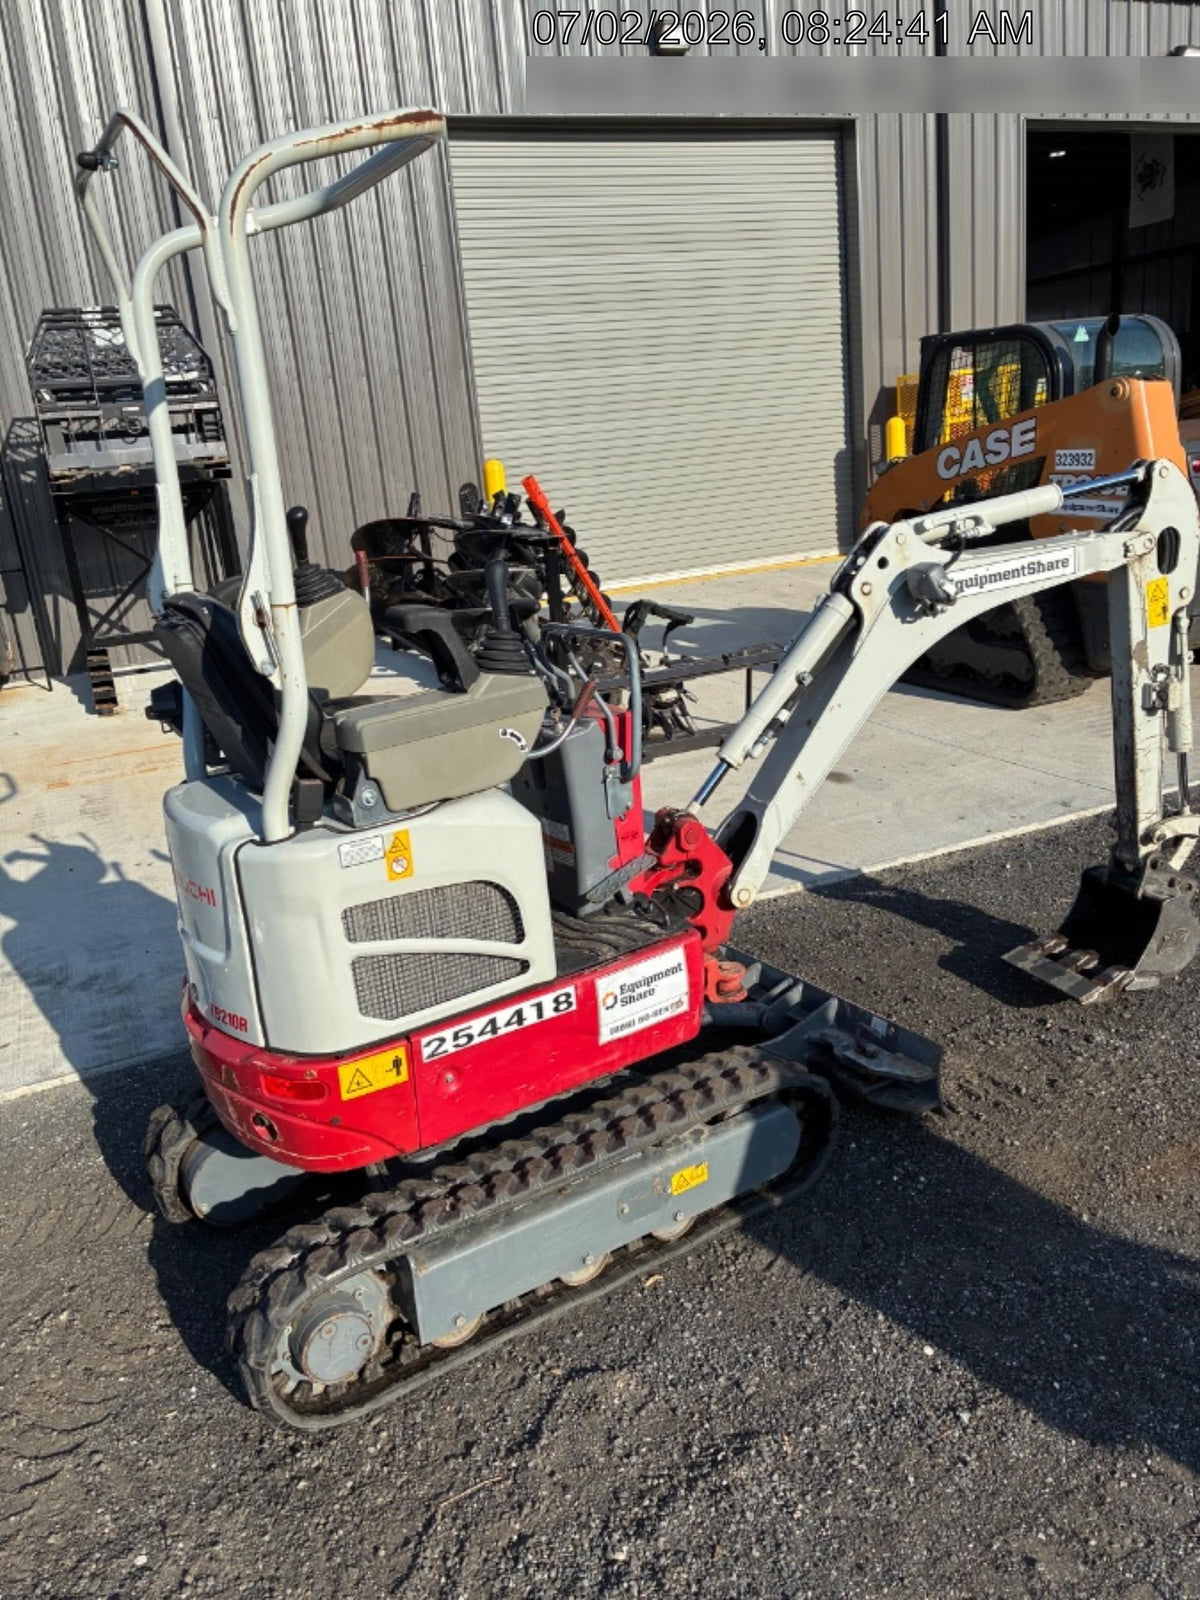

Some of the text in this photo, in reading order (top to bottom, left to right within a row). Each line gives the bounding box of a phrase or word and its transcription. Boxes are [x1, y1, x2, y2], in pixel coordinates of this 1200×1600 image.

[936, 417, 1037, 480] CASE
[1055, 452, 1094, 467] 323932
[953, 557, 1070, 593] quipmentShare
[619, 961, 684, 996] Equipment
[619, 987, 656, 1008] Share
[422, 991, 574, 1061] 254418
